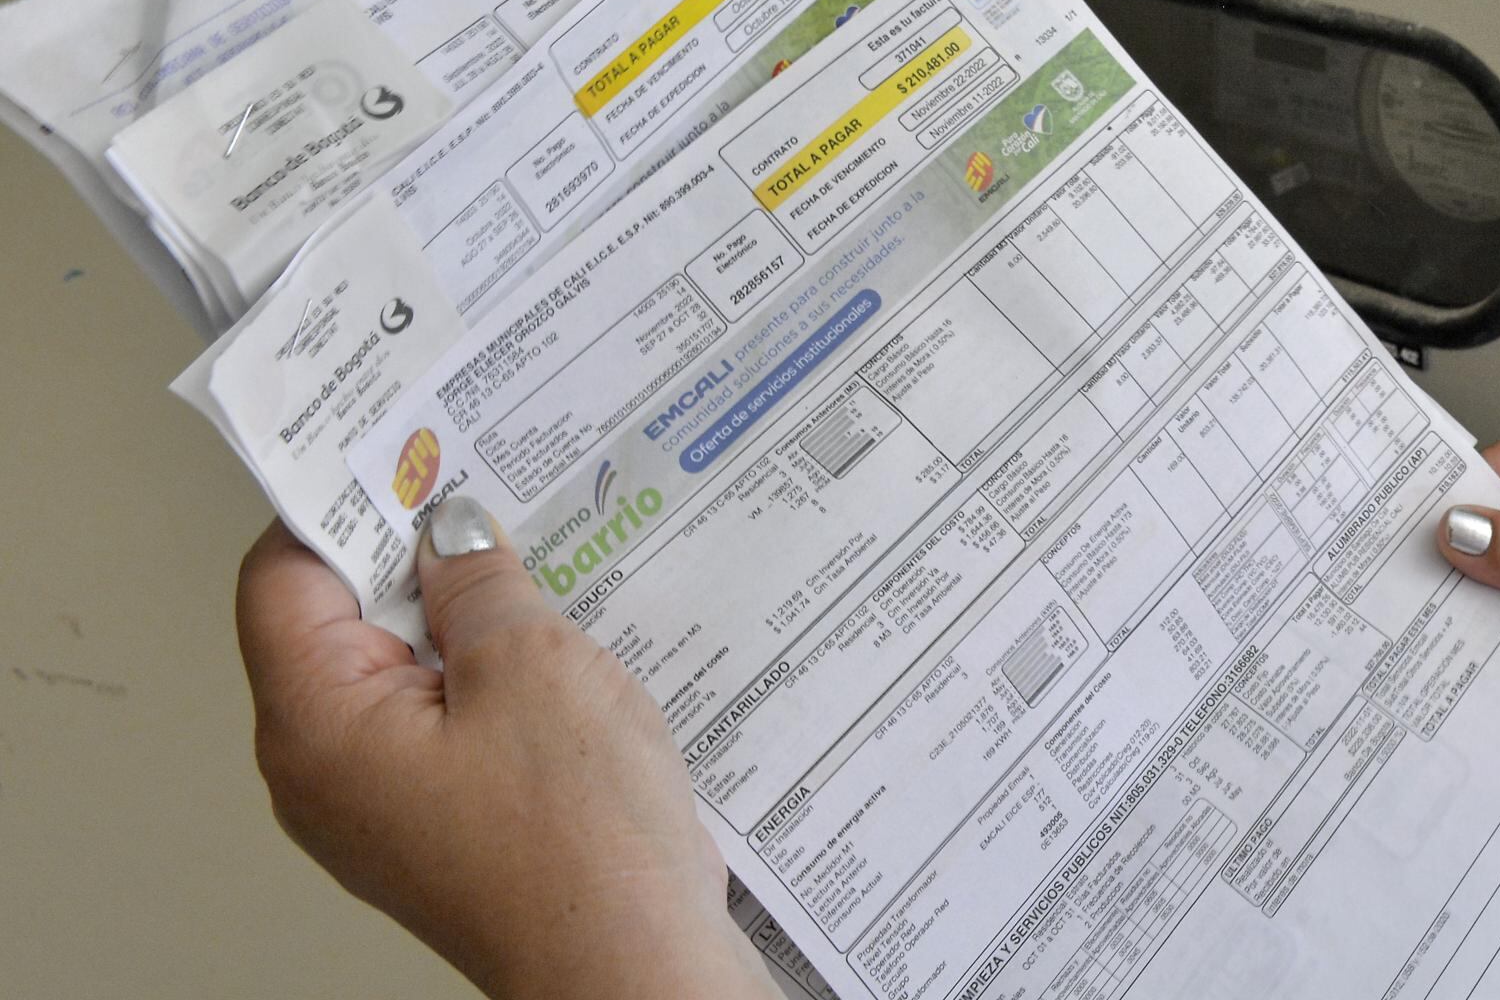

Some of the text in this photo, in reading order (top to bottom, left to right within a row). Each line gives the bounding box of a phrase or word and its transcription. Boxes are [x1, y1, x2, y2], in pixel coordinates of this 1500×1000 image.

[573, 33, 619, 75] CONTRATO
[586, 63, 629, 96] TOTAL
[629, 52, 639, 64] A
[638, 15, 679, 54] PAGAR
[867, 34, 890, 51] Esta
[889, 25, 902, 36] es
[899, 16, 912, 27] tu
[1064, 9, 1077, 21] 1/1
[605, 96, 634, 122] FECHA
[634, 84, 647, 98] DE
[646, 38, 698, 85] VENCIMIENTO
[619, 117, 648, 144] FECHA
[647, 105, 660, 119] DE
[659, 64, 706, 108] EXPEDICION
[743, 4, 780, 36] Octubre
[751, 36, 926, 176] CONTRATO 371041
[767, 42, 959, 196] TOTAL A PAGAR $ 210,481.00
[789, 58, 987, 219] FECHA DE VENCIMIENTO Noviembre 22-2022
[807, 76, 1004, 239] FECHA DE EXPEDICION Noviembre 11-2022
[545, 161, 598, 213] 281693970
[726, 234, 746, 251] Pago
[729, 255, 783, 304] 282856157
[436, 352, 490, 399] EMPRESAS
[486, 299, 548, 354] MUNICIPALES
[548, 287, 563, 301] DE
[443, 375, 473, 408] JORGE
[514, 307, 554, 342] OROZCO
[555, 278, 590, 308] GALVIS
[643, 191, 925, 440] EMCALI presente para construir junto a la
[661, 236, 904, 451] comunidad soluciones a sus necesidades.
[279, 398, 321, 443] Banco
[320, 379, 337, 400] de
[334, 331, 380, 382] Bogotá
[690, 299, 871, 462] Oferta de servicios institucionales
[959, 446, 985, 470] TOTAL
[1327, 447, 1429, 560] ALUMBRADO PUBLICO (AP)
[522, 507, 591, 571] obierno
[538, 487, 662, 596] barrio
[872, 510, 965, 602] COMPONENTES DEL COSTO
[1365, 602, 1437, 693] TOTAL A PAGAR ESTE MES
[1044, 672, 1111, 750] Componentes del Costo
[1421, 662, 1479, 736] TOTAL A PAGAR
[755, 786, 810, 842] ENERGIA
[790, 849, 826, 887] Consumo
[826, 837, 837, 849] de
[863, 785, 886, 809] activa
[1224, 817, 1272, 877] ULTIMO PAGO
[807, 854, 856, 908] Lectura Actual
[1000, 943, 1010, 954] Y
[1010, 881, 1064, 944] SERVICIOS
[1061, 823, 1112, 881] PUBLICOS
